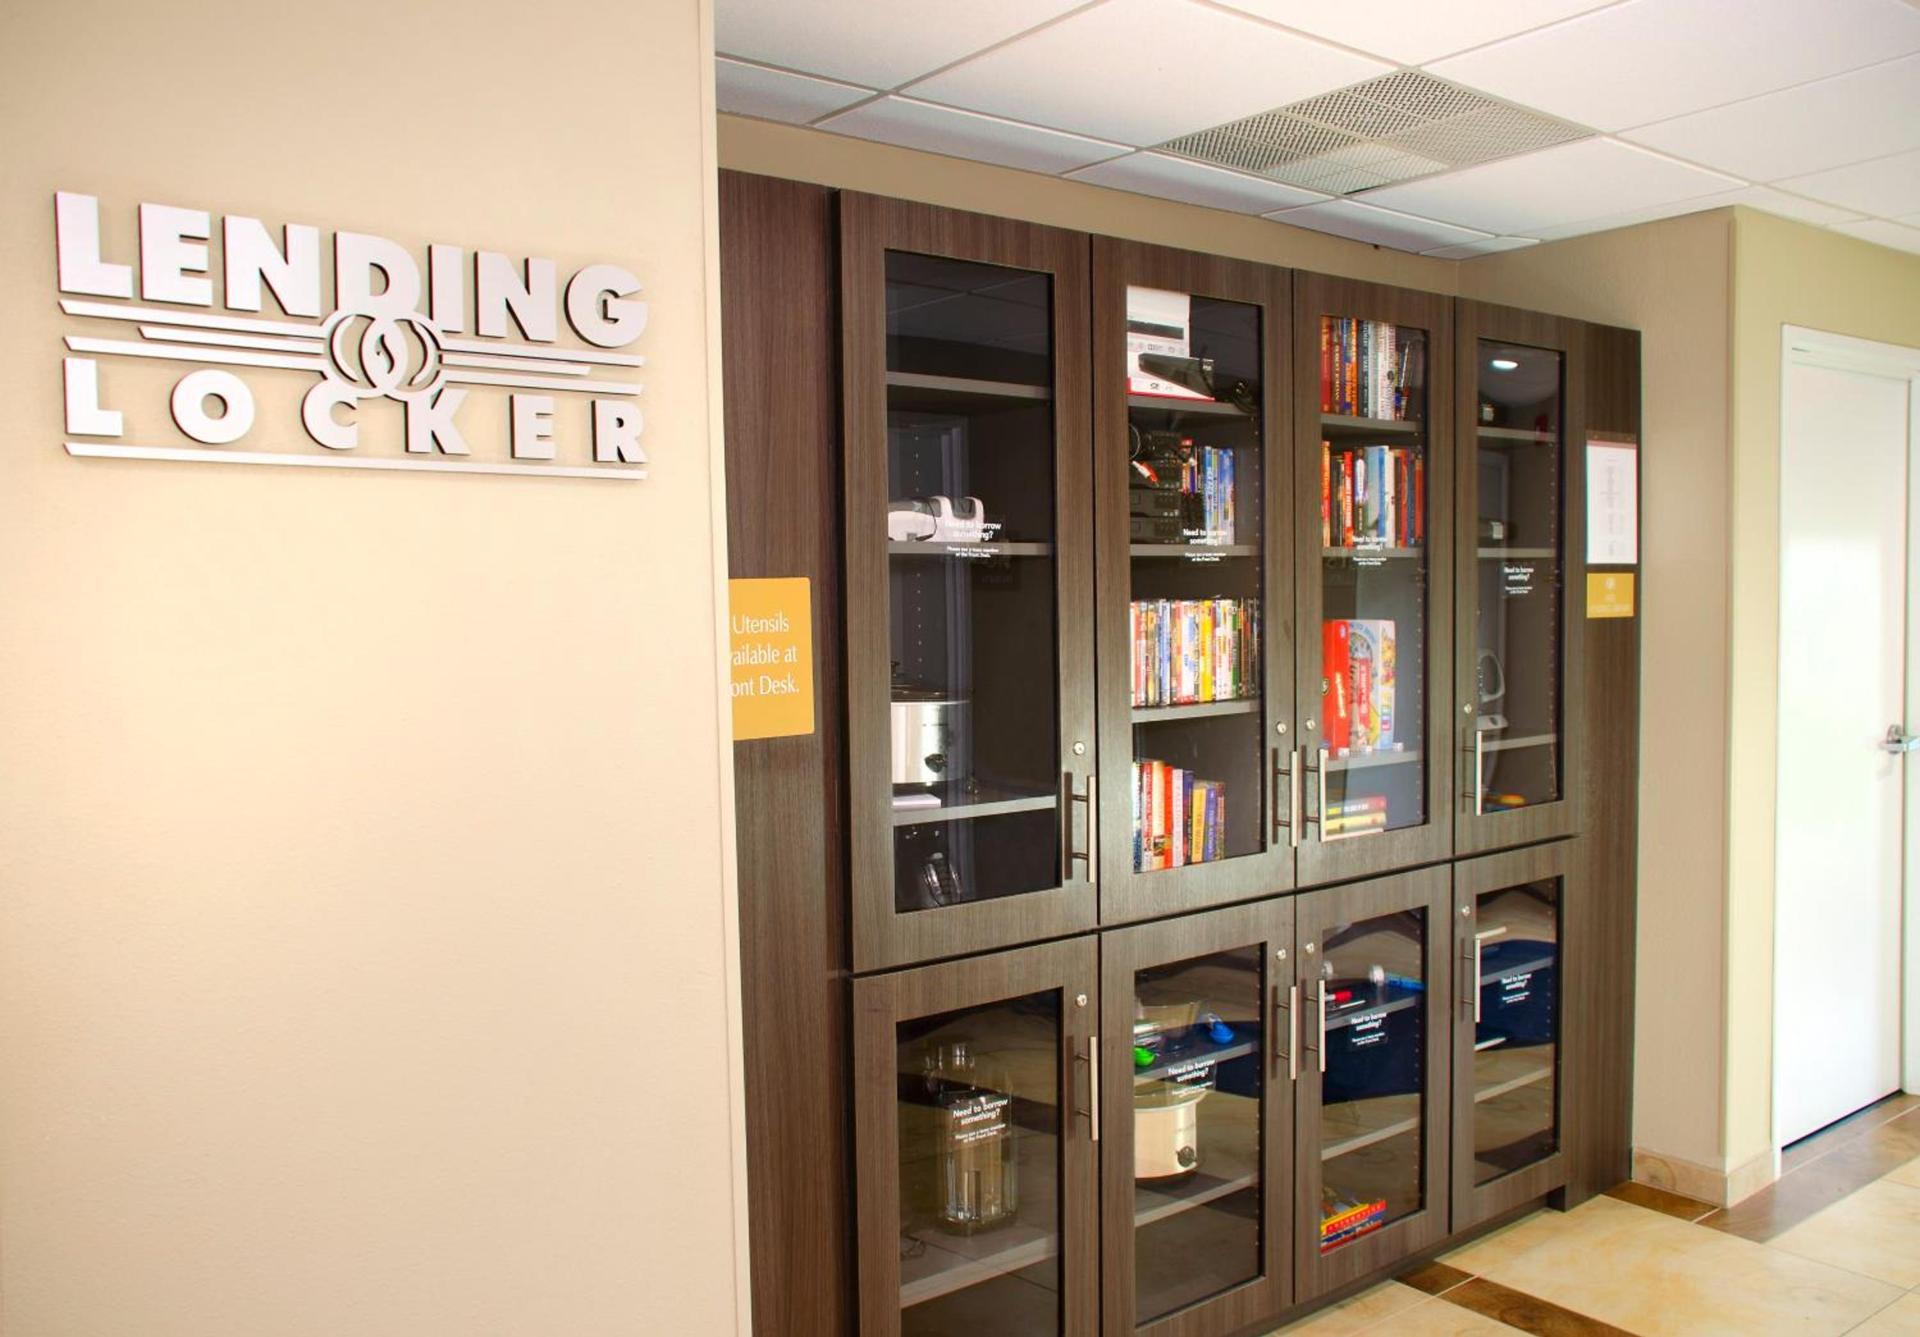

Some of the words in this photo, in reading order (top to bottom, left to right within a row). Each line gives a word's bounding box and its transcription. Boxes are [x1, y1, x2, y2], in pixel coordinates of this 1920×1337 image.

[54, 190, 649, 349] LENDING
[63, 357, 647, 464] LOCKER
[732, 611, 790, 635] Utensils
[784, 644, 798, 664] at
[760, 671, 800, 696] Desk.
